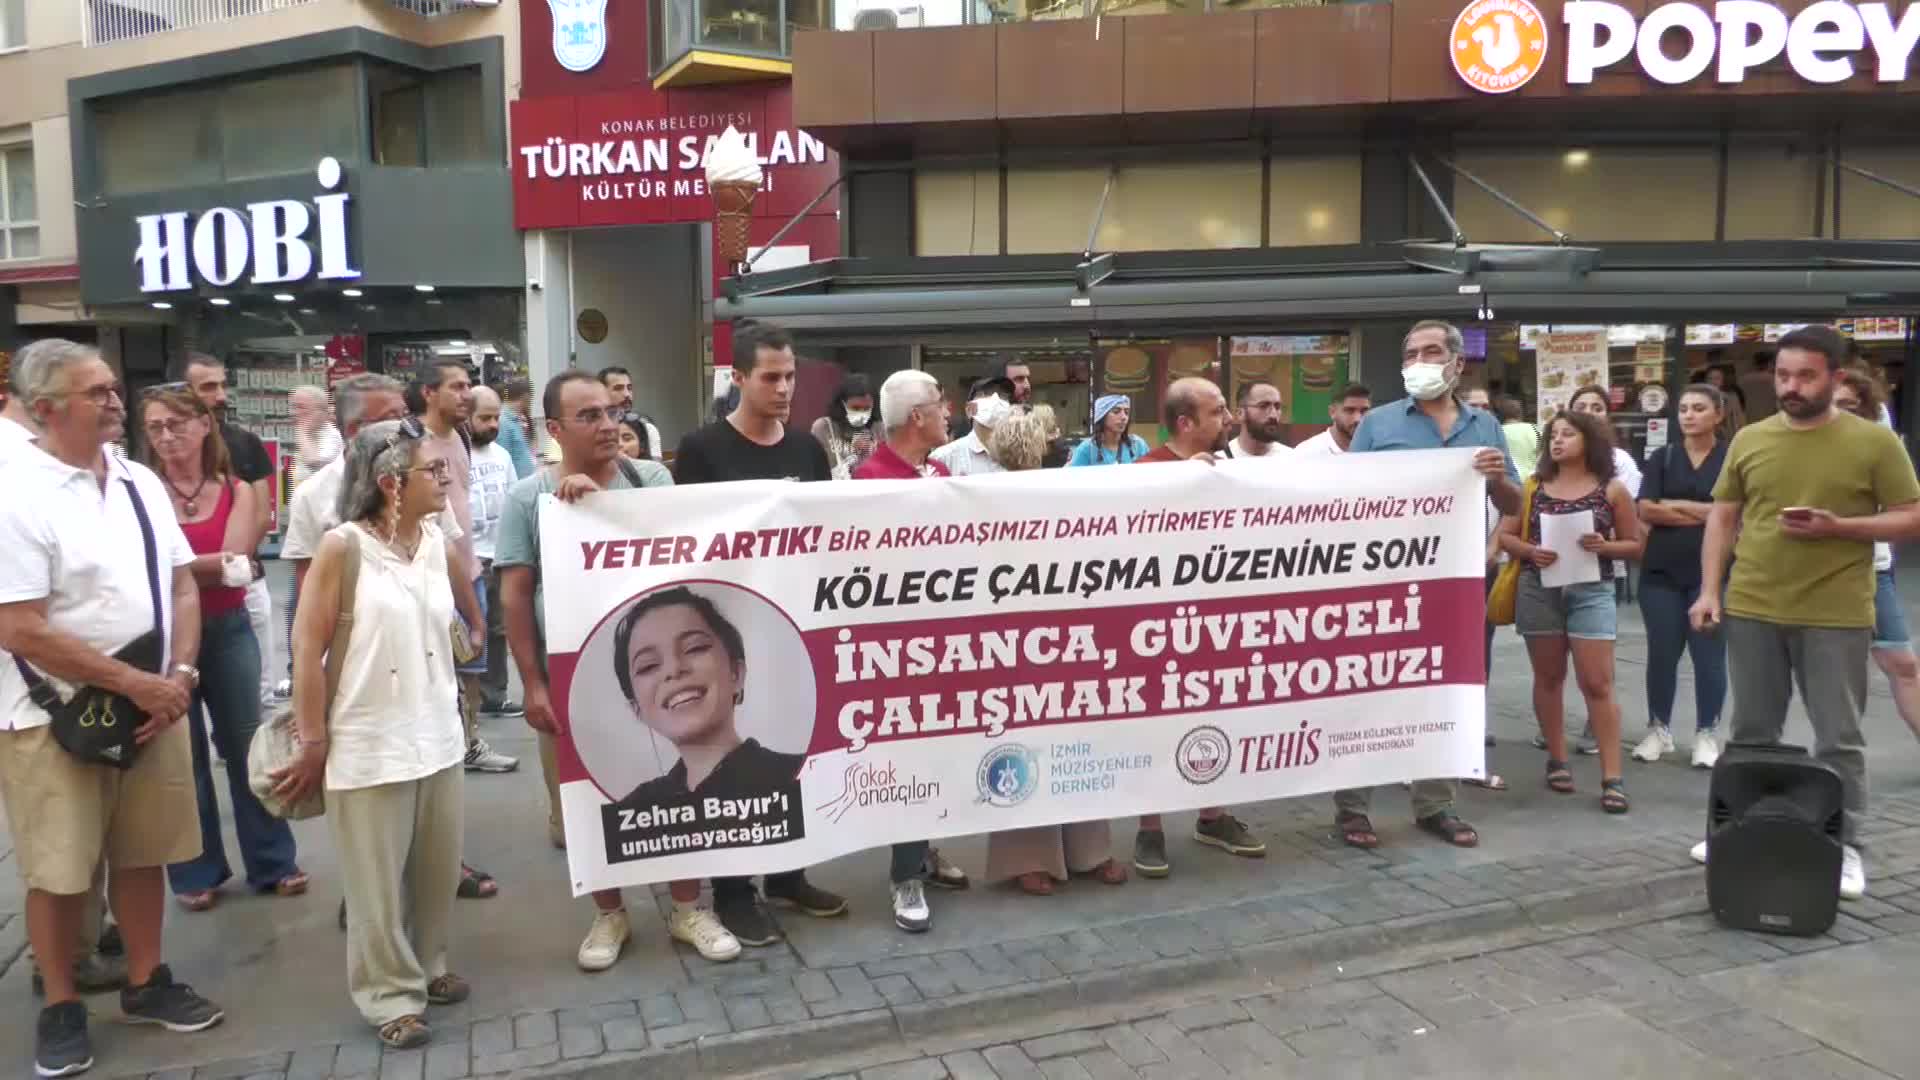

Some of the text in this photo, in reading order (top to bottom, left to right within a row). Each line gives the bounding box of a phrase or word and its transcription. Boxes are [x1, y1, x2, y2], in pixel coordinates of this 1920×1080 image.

[602, 112, 752, 134] KONAK BELEDİYESİ
[520, 137, 669, 179] TÜRKAN
[582, 179, 667, 200] KÜLTÜR
[134, 156, 361, 292] HOBİ
[580, 495, 1455, 570] YETER ARTIK! BİR ARKADAŞIMIZI DAHA YİTİRMEYE TAHAMMÜLÜMÜZ YOK!
[813, 535, 1441, 613] KÖLECE ÇALIŞMA DÜZENİNE SON!
[834, 583, 1422, 684] İNSANCA, GÜVENCELİ
[837, 645, 1444, 753] ÇALIŞMAK İSTİYORUZ!
[1050, 754, 1153, 777] MÜZİSYENLER
[1239, 719, 1322, 775] TEHİS
[1050, 775, 1116, 795] DERNEĞİ
[617, 804, 697, 832] Zehra
[621, 820, 789, 857] unutmayacağız!
